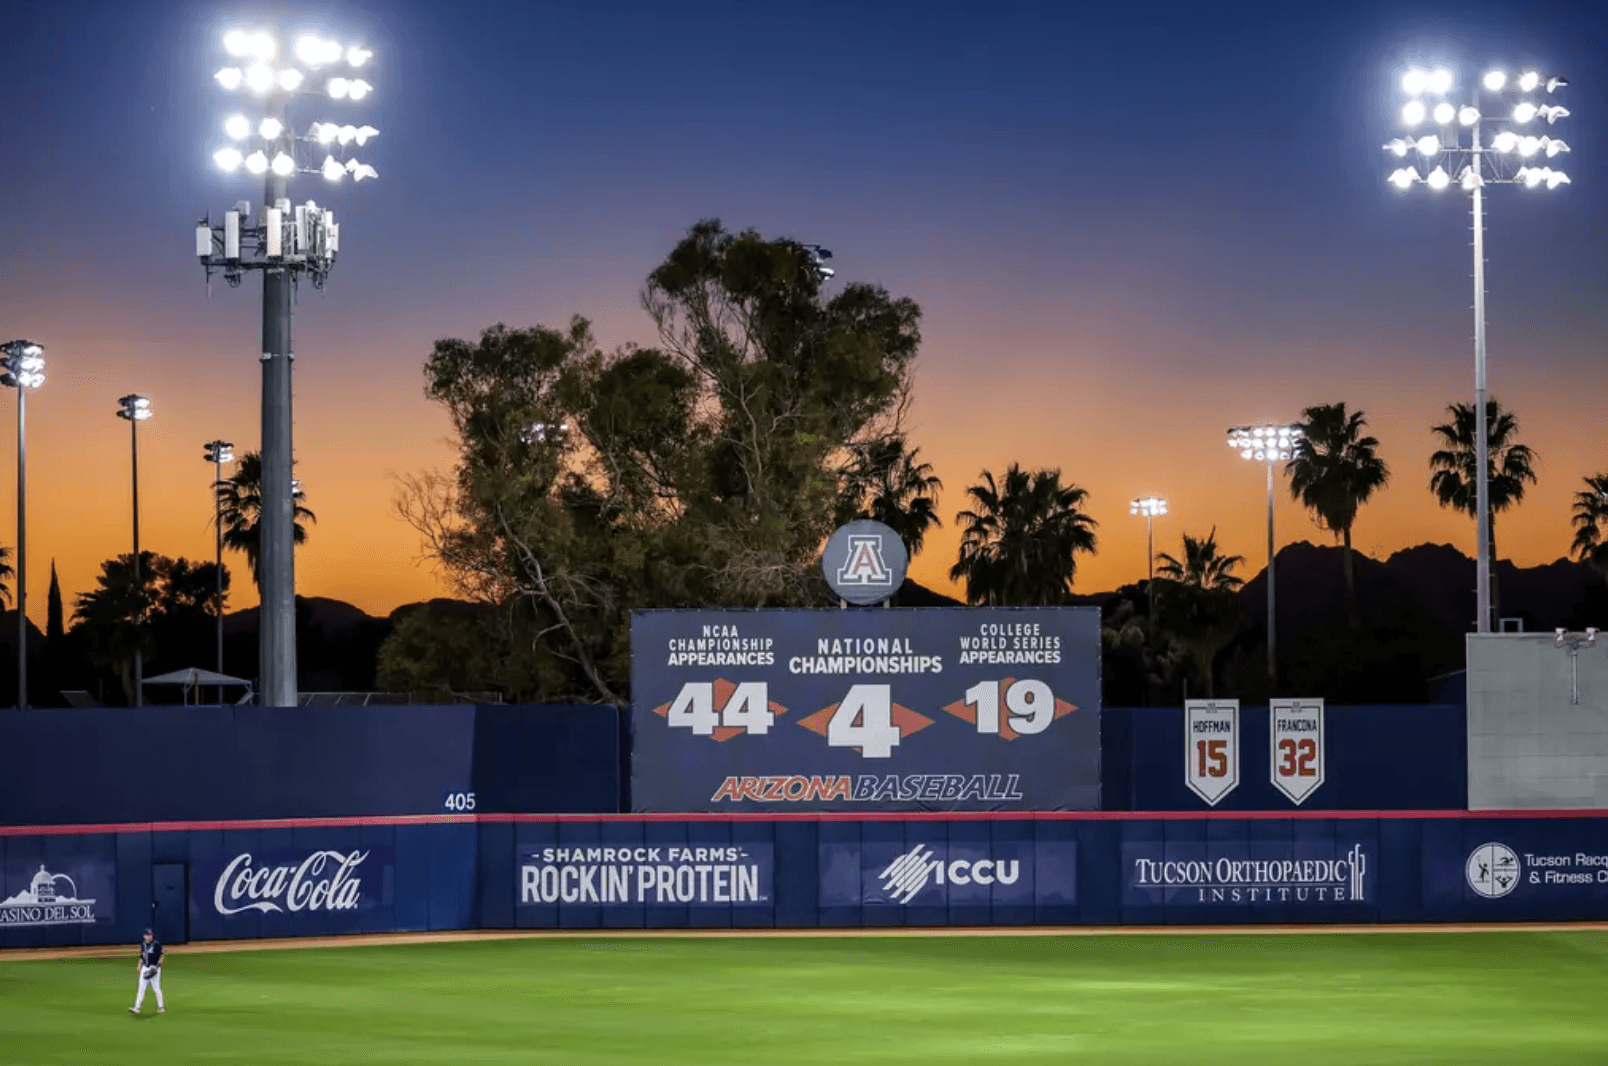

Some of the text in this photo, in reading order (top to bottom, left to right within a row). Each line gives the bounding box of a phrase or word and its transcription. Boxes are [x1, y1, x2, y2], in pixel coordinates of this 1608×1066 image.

[837, 535, 892, 585] A
[703, 625, 738, 637] NCAA
[980, 624, 1040, 636] COLLEGE
[669, 639, 773, 651] CHAMPIONSHIP
[817, 638, 913, 655] NATIONAL
[960, 637, 1061, 649] WORLD SERIES
[667, 652, 775, 666] APPEARANCES
[789, 656, 943, 674] CHAMPIONSHIPS
[959, 651, 1061, 664] APPEARANCES
[668, 682, 774, 735] 44
[965, 679, 1055, 735] 19
[828, 684, 900, 758] 4
[1193, 720, 1231, 733] HOFFMAN
[1277, 719, 1317, 732] FRANCONA
[1197, 739, 1227, 778] 15
[1279, 738, 1316, 777] 32
[710, 774, 1023, 802] ARIZONA BASEBALL
[444, 793, 476, 811] 405
[543, 848, 661, 862] SHAMROCK
[1524, 854, 1570, 867] Tucson
[935, 860, 1019, 885] ICCU
[1529, 871, 1541, 884] &
[1545, 871, 1593, 884] Fitness
[214, 849, 370, 915] Coca-Cola
[638, 865, 758, 903] PROTEIN
[1199, 887, 1345, 902] INSTITUTE
[0, 904, 95, 921] ASINO DEL SOL
